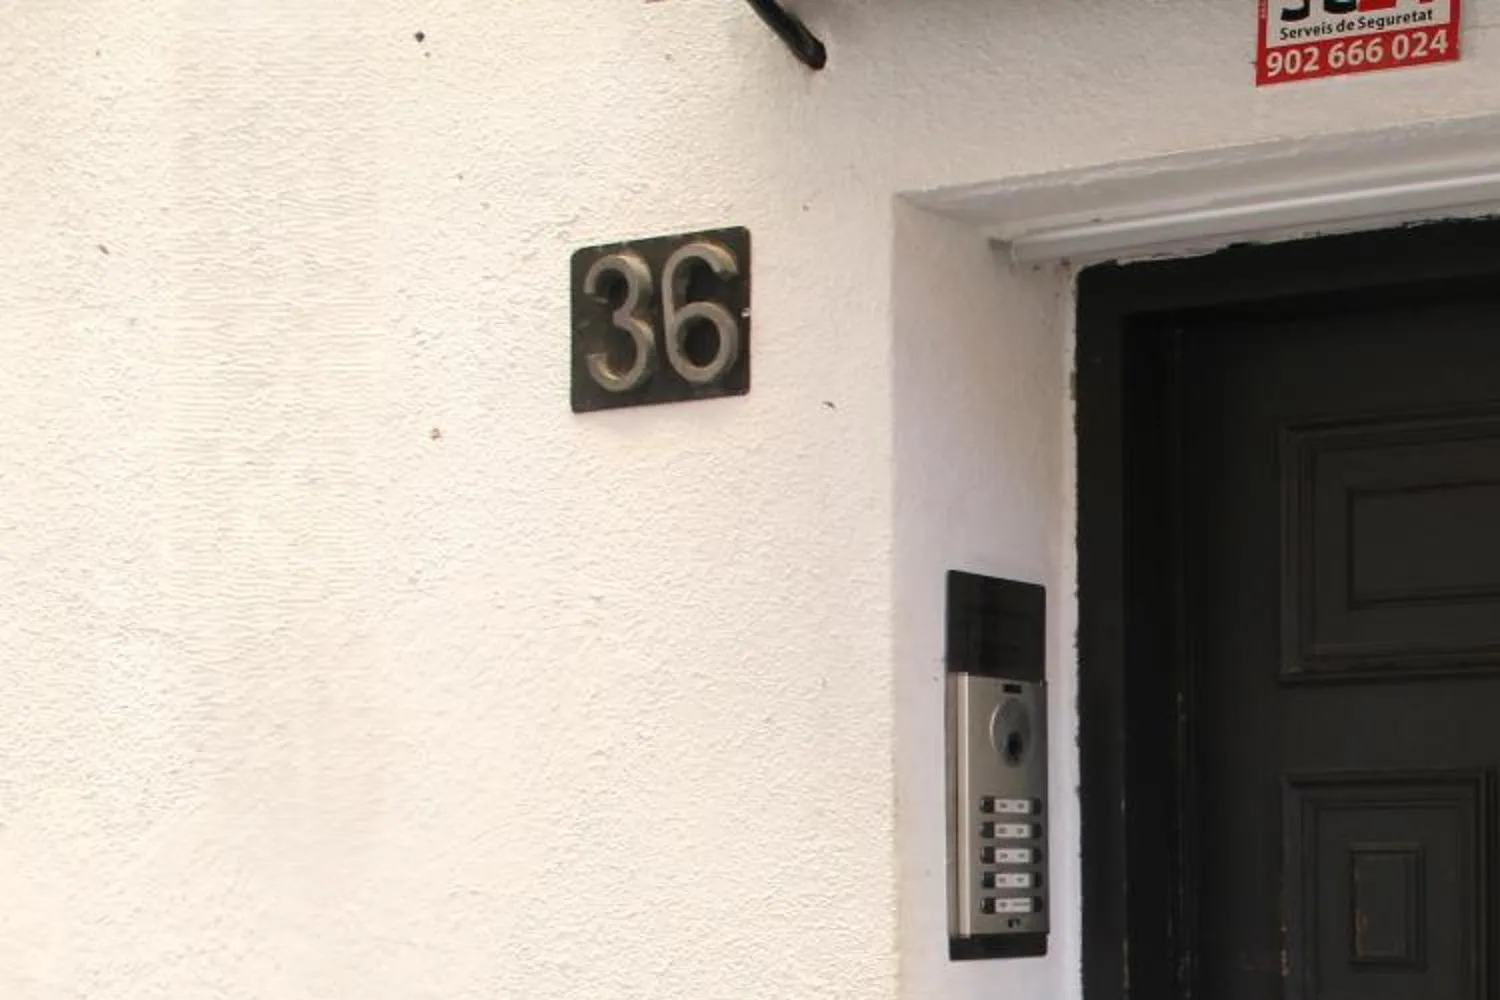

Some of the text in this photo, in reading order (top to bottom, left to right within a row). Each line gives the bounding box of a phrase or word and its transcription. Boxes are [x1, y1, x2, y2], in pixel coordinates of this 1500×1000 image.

[1280, 21, 1333, 40] Serveis
[1336, 19, 1355, 33] de
[1359, 9, 1433, 30] Seguretat
[1266, 29, 1449, 77] 902 666 024
[583, 242, 740, 392] 36
